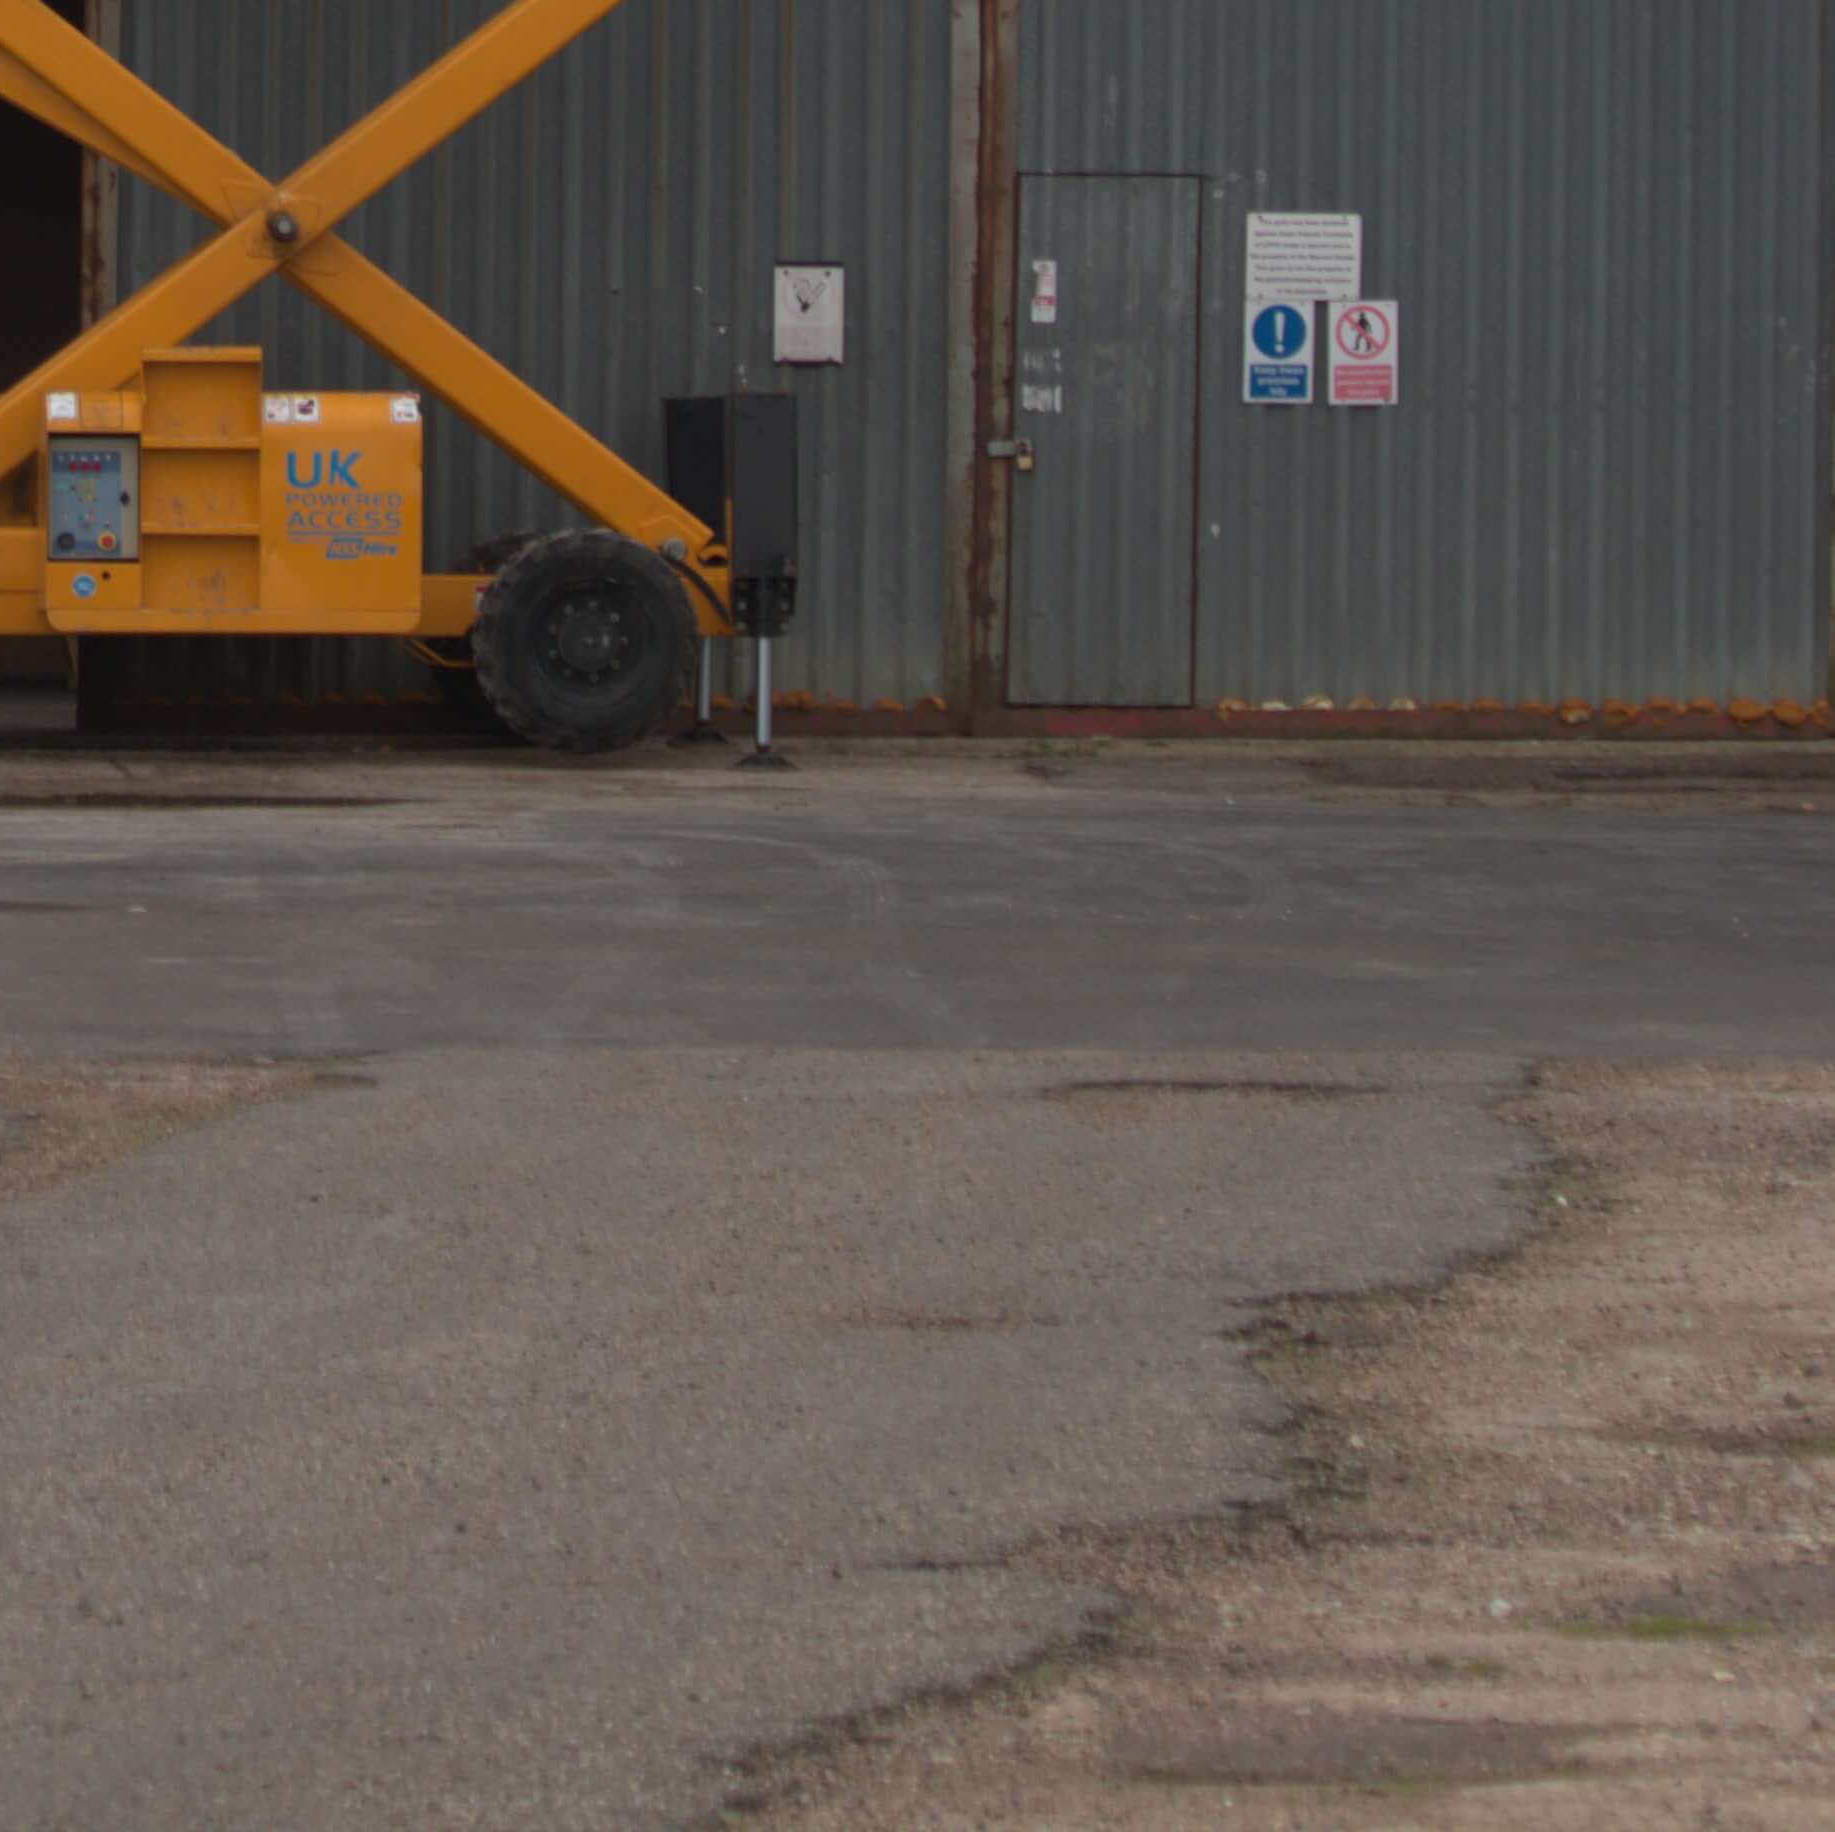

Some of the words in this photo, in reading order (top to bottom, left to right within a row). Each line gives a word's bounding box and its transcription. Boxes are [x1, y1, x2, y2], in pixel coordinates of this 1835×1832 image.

[285, 449, 362, 490] UK
[285, 491, 403, 508] POWERED
[287, 510, 402, 529] ACCESS
